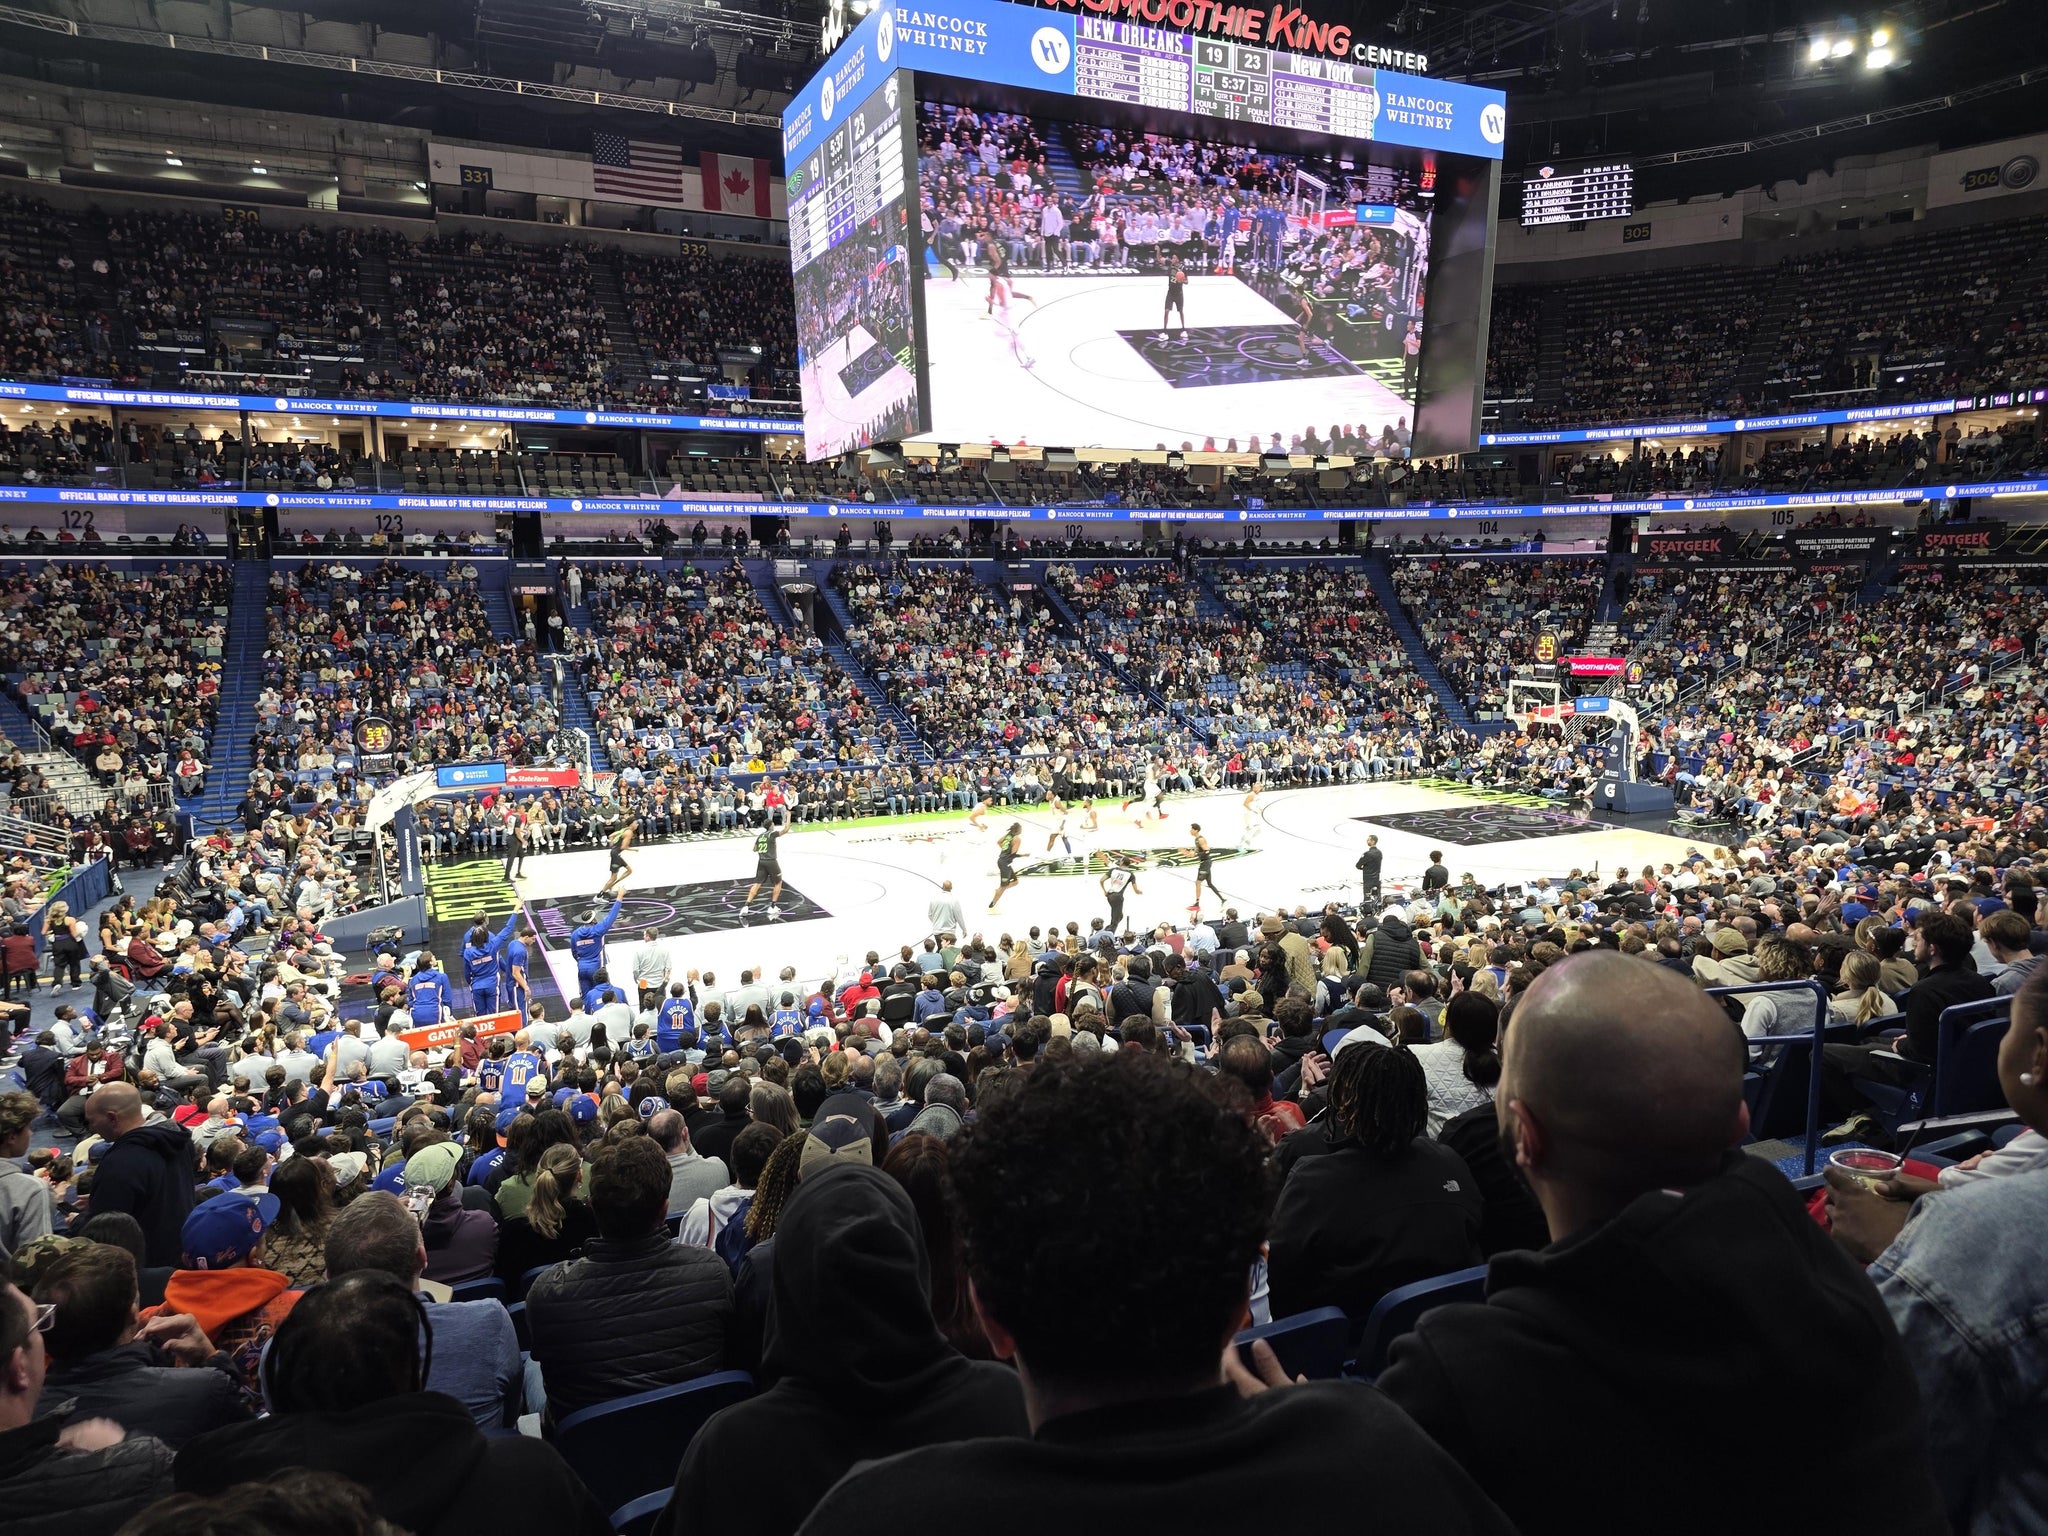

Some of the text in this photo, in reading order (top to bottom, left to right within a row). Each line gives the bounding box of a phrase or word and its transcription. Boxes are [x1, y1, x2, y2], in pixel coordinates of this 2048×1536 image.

[896, 8, 988, 37] HANCOCK
[896, 27, 988, 56] WHITNEY
[1083, 16, 1184, 53] NEW ORLEANS
[1098, 50, 1122, 60] FEARS
[1206, 46, 1222, 63] 19
[1244, 53, 1261, 70] 23
[1354, 43, 1428, 73] CENTER
[835, 45, 865, 84] HANCOCK
[1290, 54, 1354, 83] New York
[1222, 76, 1245, 90] 5:37
[1200, 88, 1210, 96] FT
[1194, 100, 1218, 110] FOULS
[1254, 96, 1264, 104] FT
[1386, 92, 1454, 115] HANCOCK
[1248, 108, 1270, 116] FOULS
[787, 104, 812, 137] HANCOCK
[854, 112, 866, 142] 23
[1386, 108, 1453, 132] WHITNEY
[830, 130, 844, 158] 5:37
[463, 169, 488, 184] 331
[810, 157, 819, 182] 19
[1967, 170, 1999, 187] 306
[1624, 226, 1650, 240] 305
[681, 242, 708, 256] 332
[291, 402, 377, 412] HANCOCK WHITNEY
[1979, 398, 1986, 407] 2
[1959, 484, 2038, 494] HANCOCK WHITNEY
[60, 491, 238, 504] OFFICIAL BANK OF THE NEW ORLEANS PELICANS
[399, 498, 547, 509] OFFICIAL BANK OF THE NEW ORLEANS PELICANS
[61, 510, 94, 529] 122
[375, 514, 403, 531] 123
[1771, 510, 1794, 524] 105
[872, 520, 891, 534] 101
[1065, 525, 1082, 539] 102
[1242, 525, 1261, 538] 103
[1478, 522, 1498, 535] 104
[1650, 538, 1722, 553] SEATGEEK
[1925, 532, 1990, 548] SEATGEEK
[1538, 644, 1554, 659] 23
[1571, 662, 1604, 670] SMOOTHIE
[366, 726, 387, 737] 5:37
[366, 737, 385, 748] 23
[758, 843, 767, 853] 22
[672, 1014, 684, 1030] 11
[428, 1020, 496, 1042] GATADE
[782, 1024, 794, 1035] 11
[509, 1058, 534, 1069] BRUNSON
[486, 1075, 496, 1088] 11
[511, 1067, 526, 1085] 11
